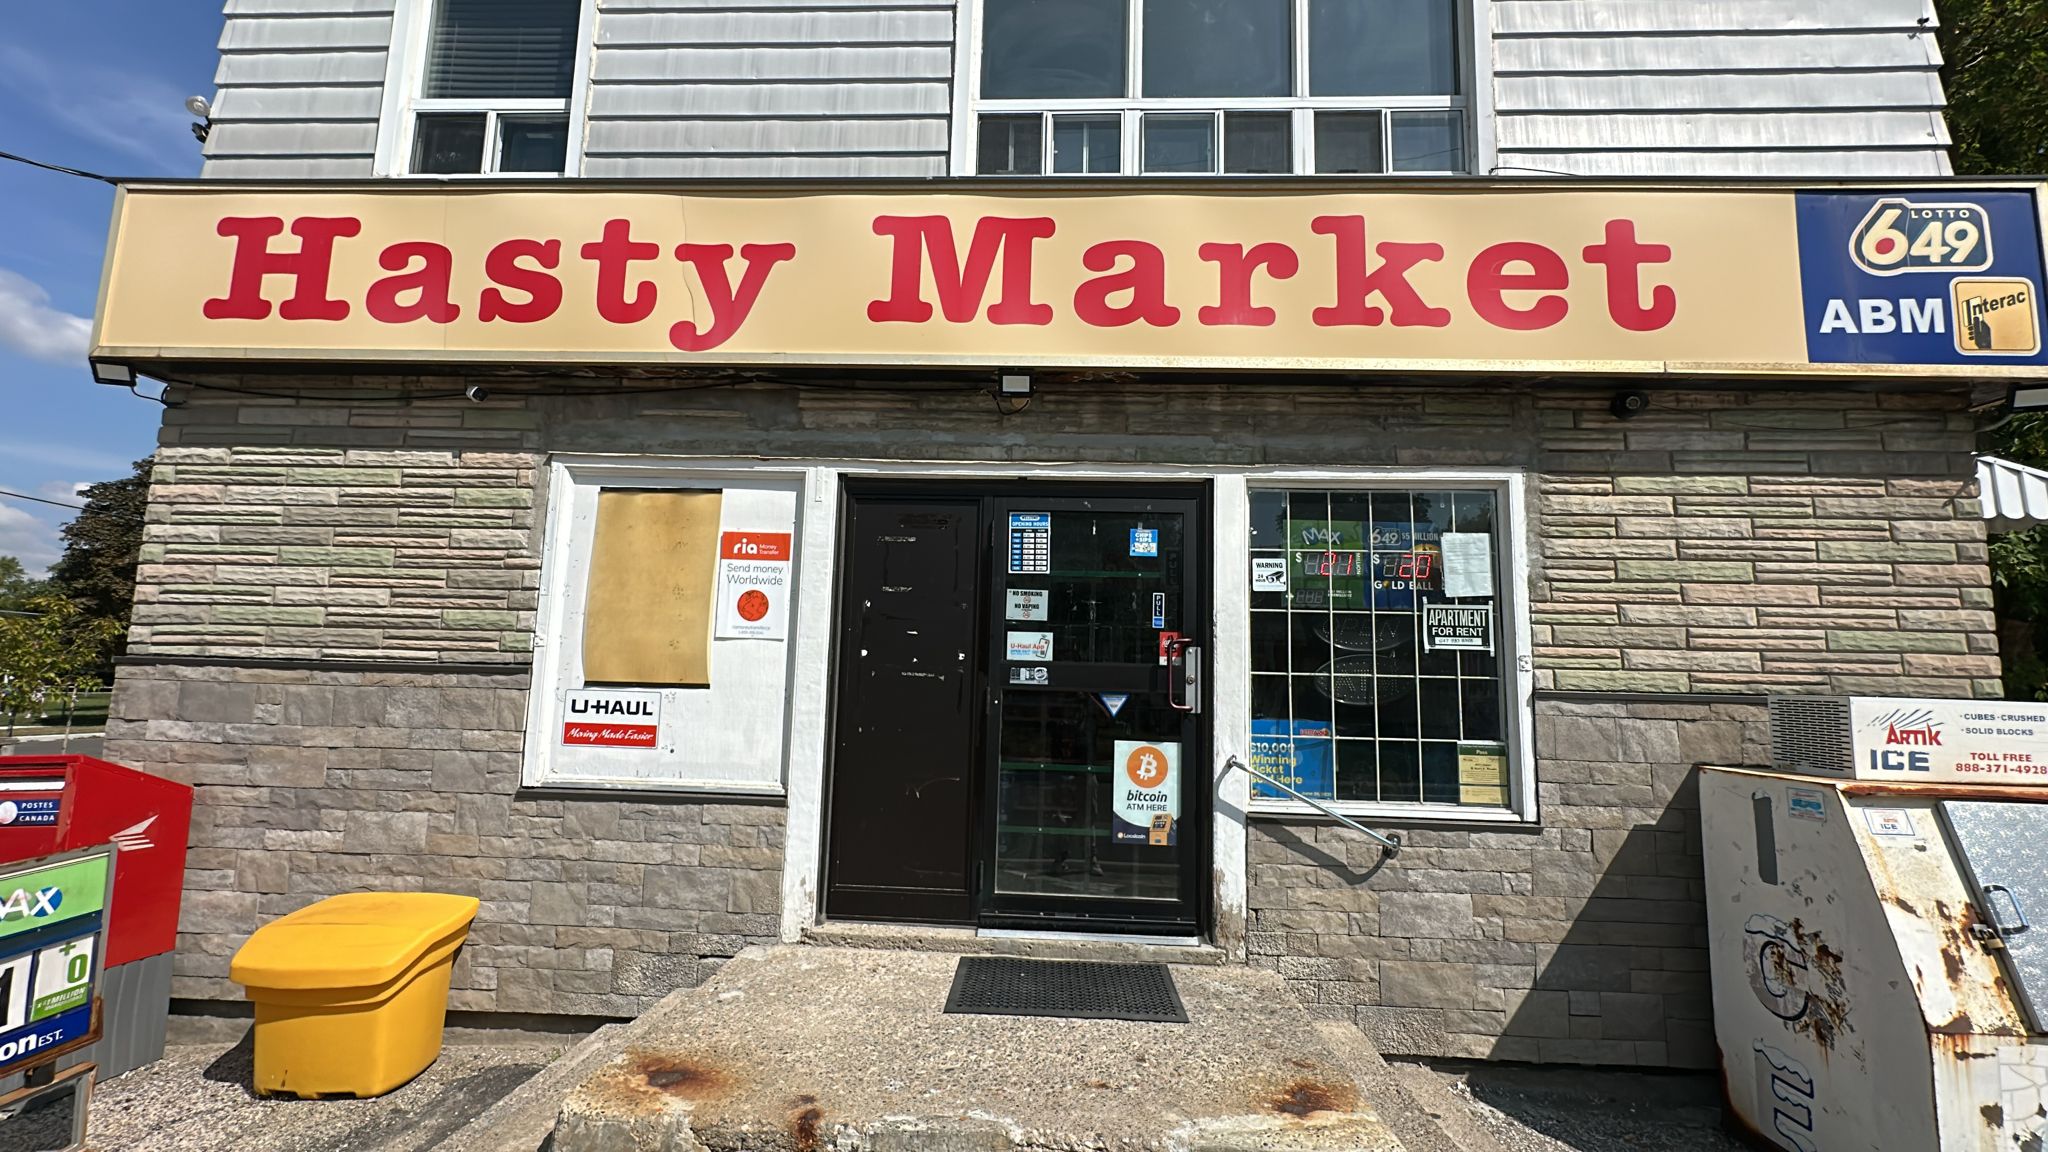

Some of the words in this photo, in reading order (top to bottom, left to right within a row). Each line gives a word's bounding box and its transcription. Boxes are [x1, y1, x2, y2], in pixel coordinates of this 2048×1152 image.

[1910, 209, 1970, 219] LOTTO
[203, 216, 796, 352] Hasty
[866, 214, 1677, 332] Market
[1819, 298, 1946, 334] ABM
[1966, 290, 2026, 328] Interac
[1302, 527, 1341, 545] MAX
[733, 537, 758, 554] ria
[727, 562, 751, 573] Send
[752, 565, 784, 575] money
[726, 574, 783, 586] Worldwide
[1428, 609, 1487, 627] APARTMENT
[1432, 626, 1453, 636] FOR
[1456, 627, 1484, 637] RENT
[1010, 642, 1032, 650] U-Haul
[1032, 643, 1045, 651] App
[571, 698, 653, 716] U-HAUL
[1964, 713, 1996, 721] CUBES
[2000, 714, 2046, 723] CRUSHED
[567, 728, 599, 742] Moving
[598, 728, 625, 740] Made
[1965, 727, 1994, 736] SOLID
[1996, 727, 2034, 737] BLOCKS
[1250, 754, 1297, 768] Winning
[1870, 748, 1931, 772] ICE
[1970, 752, 2000, 762] TOLL
[2002, 753, 2033, 763] FREE
[1955, 763, 2048, 776] 888-371-4928
[1126, 789, 1168, 803] bitcoin
[21, 801, 54, 809] POSTES
[1126, 803, 1144, 811] ATM
[1146, 804, 1168, 812] HERE
[19, 814, 55, 822] CANADA
[0, 886, 59, 920] AX
[38, 1028, 64, 1047] EST.
